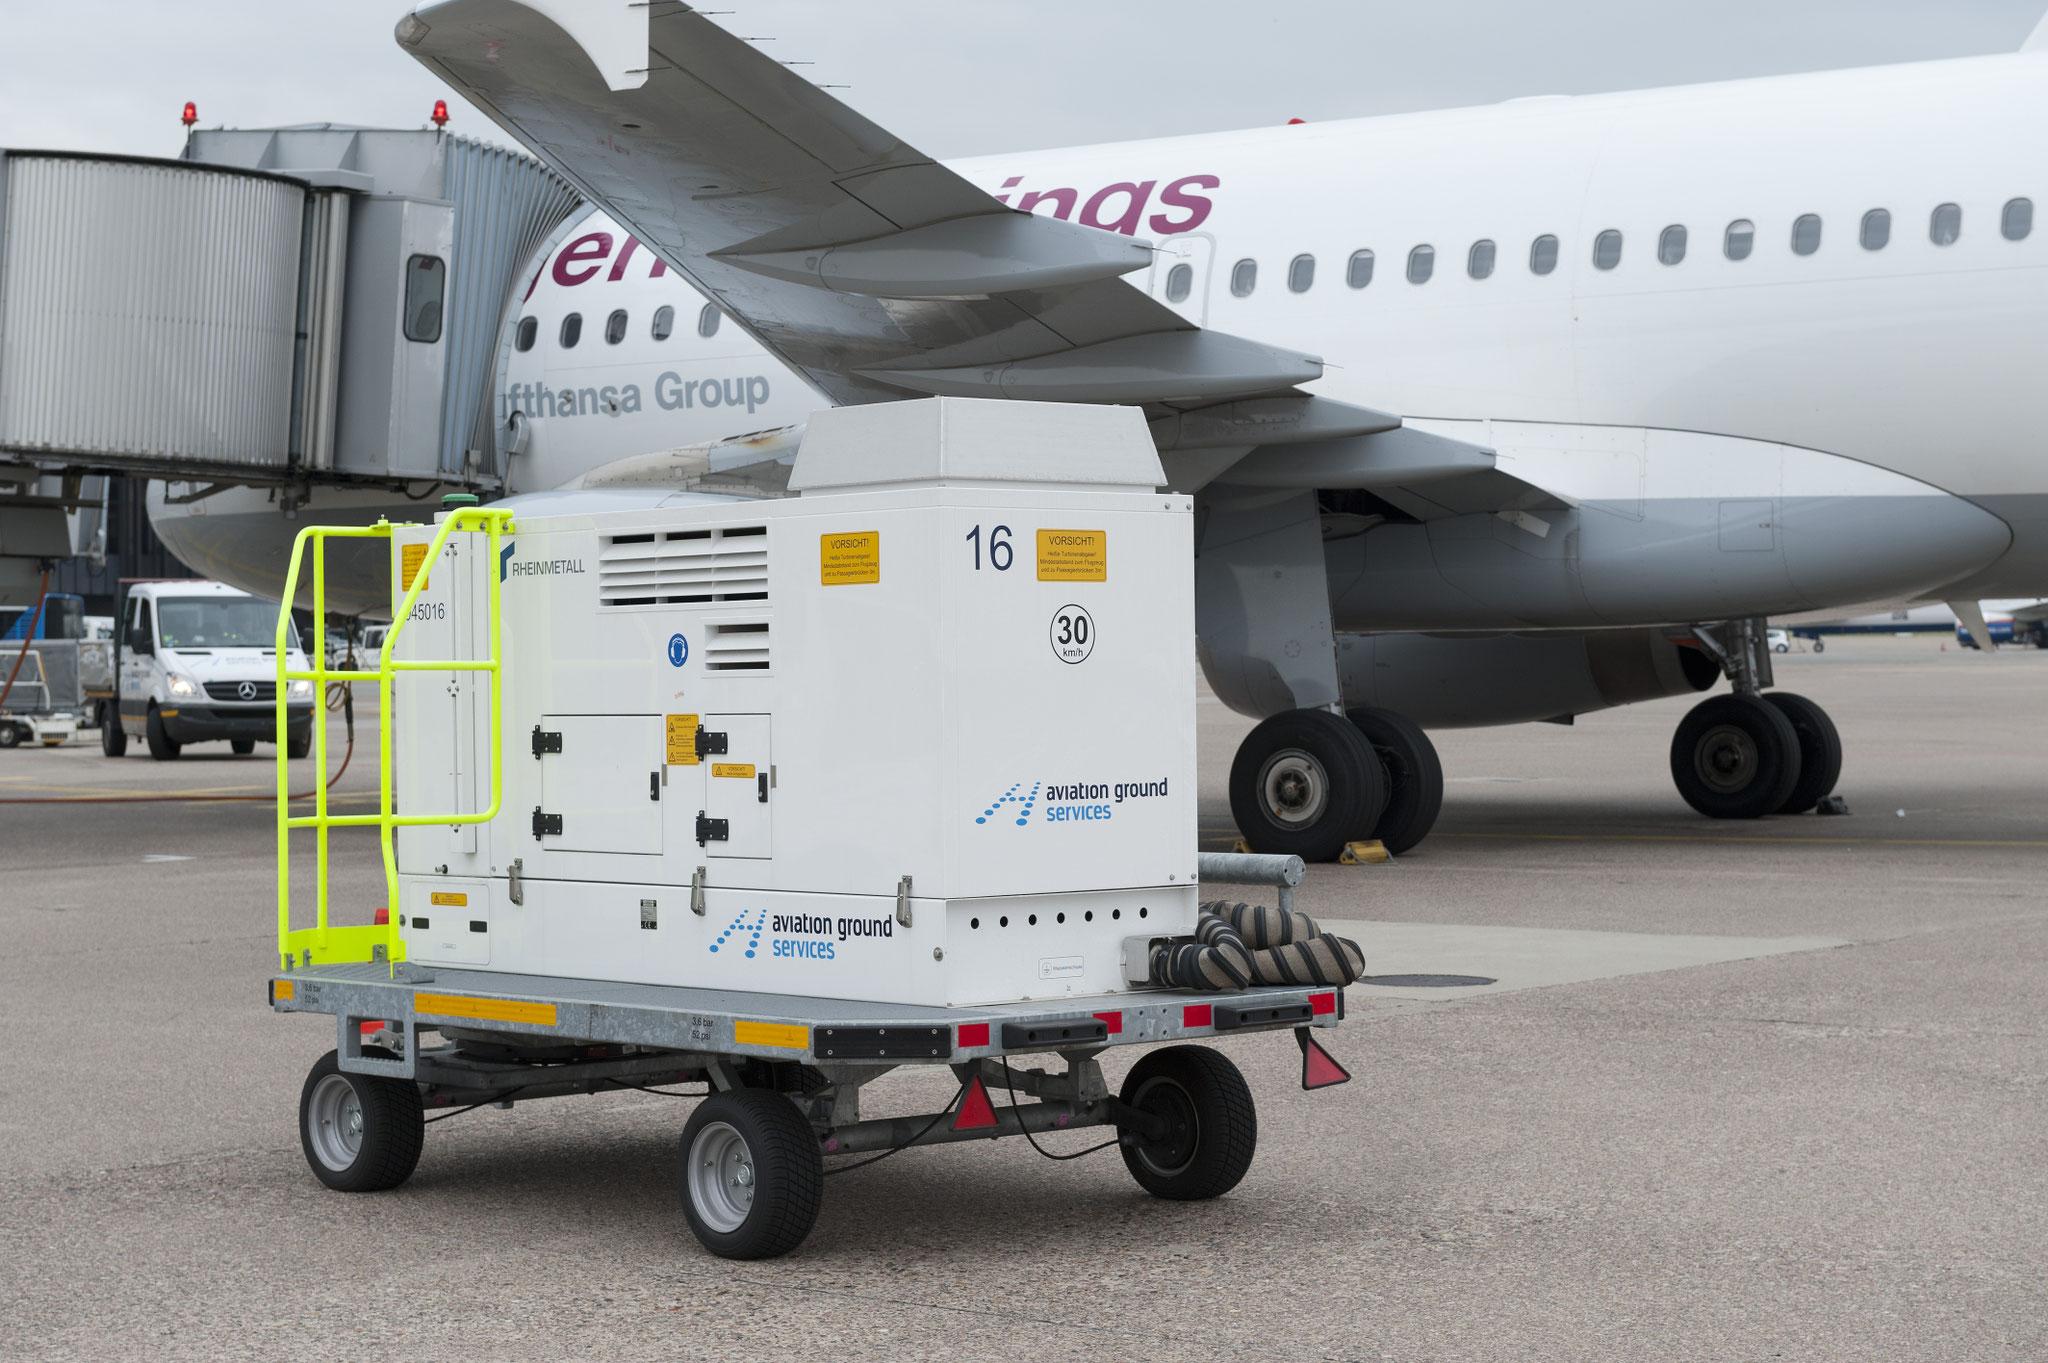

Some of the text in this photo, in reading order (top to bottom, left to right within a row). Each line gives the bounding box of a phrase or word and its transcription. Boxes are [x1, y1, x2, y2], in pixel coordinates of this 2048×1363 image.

[502, 371, 770, 419] fthansa Group
[830, 538, 870, 549] VORSICHT!
[966, 524, 1014, 571] 16
[1048, 535, 1095, 546] VORSICHT!
[512, 559, 585, 577] RHEINMETALL
[1057, 615, 1089, 645] 30
[1062, 647, 1084, 657] km/h
[1046, 777, 1168, 804] aviation ground
[1046, 804, 1112, 822] services
[772, 913, 893, 941] aviation ground
[772, 939, 836, 960] services
[702, 1017, 714, 1027] bar
[692, 1029, 711, 1044] 52 psi
